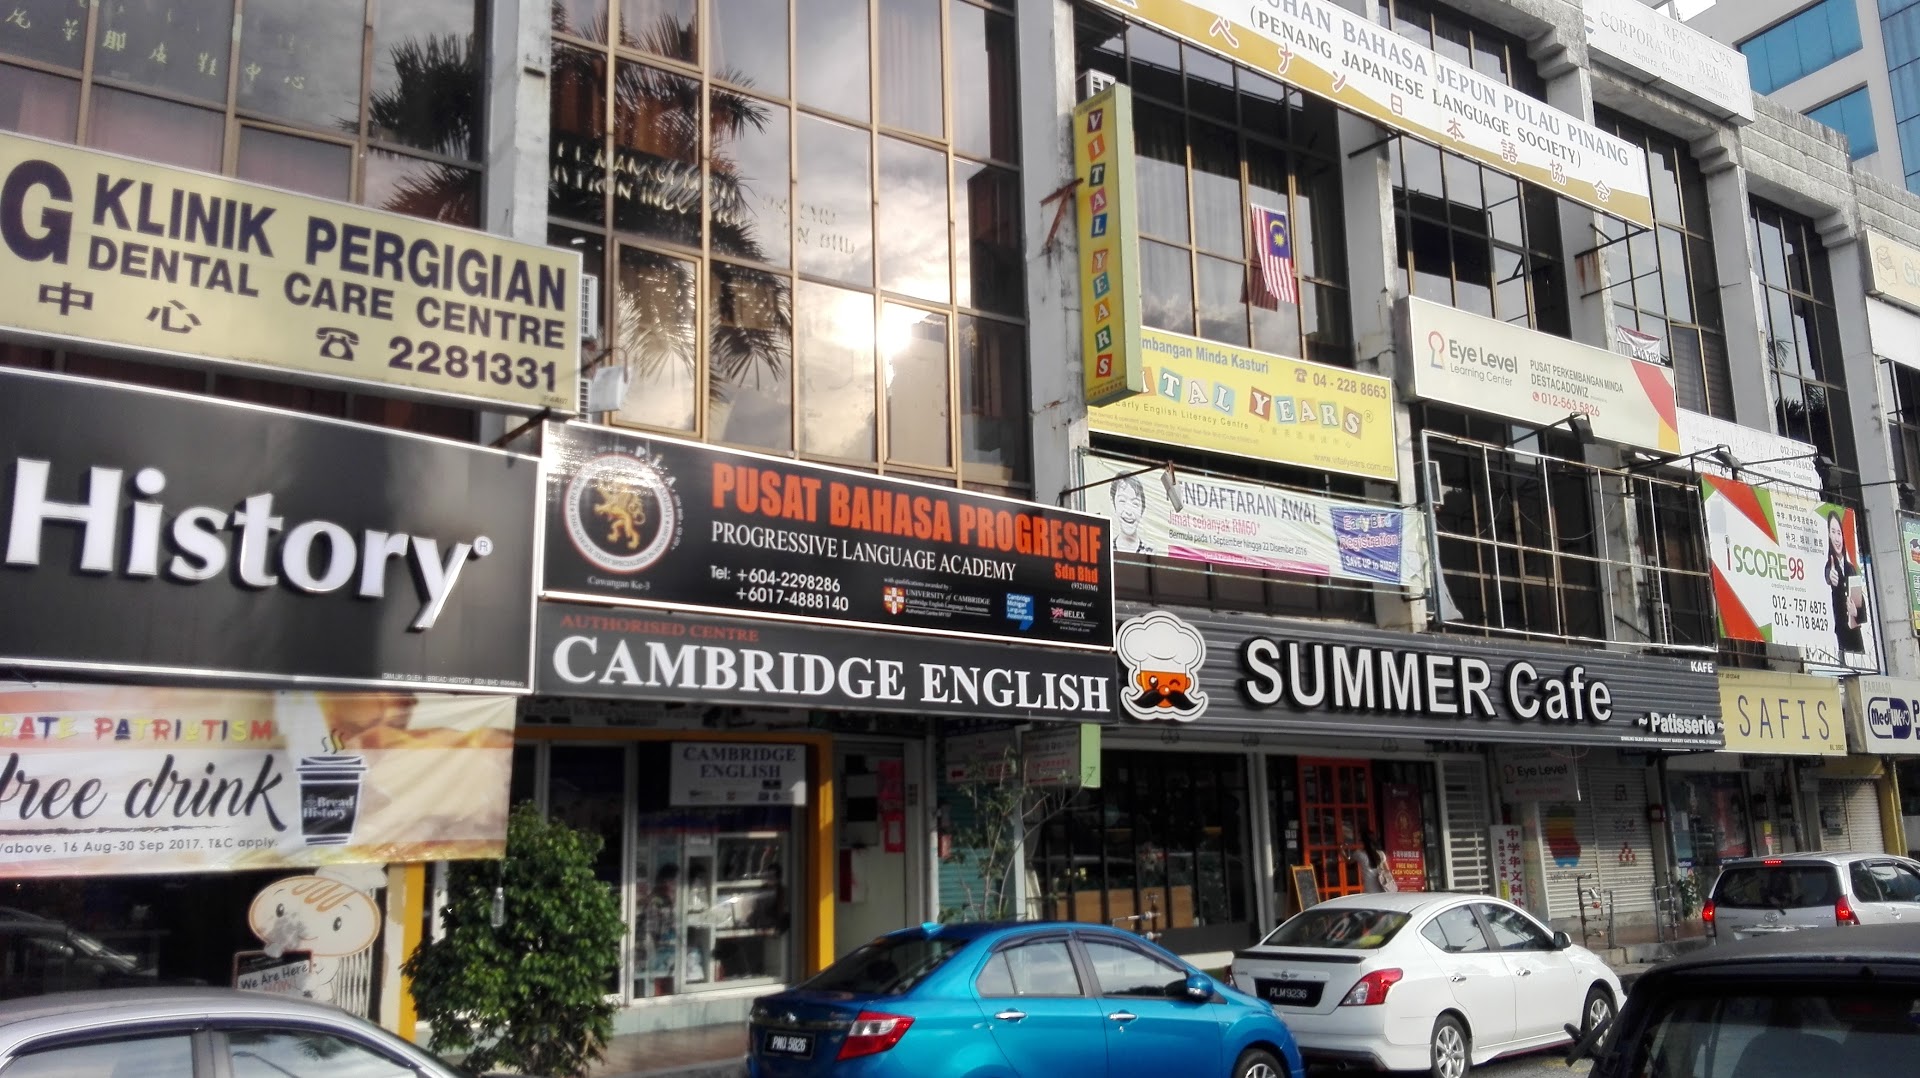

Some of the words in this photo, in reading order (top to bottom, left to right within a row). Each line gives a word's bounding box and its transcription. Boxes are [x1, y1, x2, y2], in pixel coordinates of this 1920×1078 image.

[1600, 11, 1690, 68] CORPORATION
[1250, 6, 1334, 60] (PENANG
[1341, 50, 1425, 99] JAPANESE
[1433, 90, 1511, 137] LANGUAGE
[1517, 127, 1582, 168] SOCIETY)
[1342, 18, 1428, 77] BAHASA
[1437, 63, 1497, 107] JEPUN
[1503, 94, 1560, 135] PULAU
[1567, 123, 1629, 166] PINANG
[1089, 111, 1105, 234] VITAL
[0, 159, 73, 264] G
[92, 172, 277, 258] KLINIK
[305, 215, 566, 312] PERGIGIAN
[88, 236, 259, 298] DENTAL
[284, 272, 394, 321] CARE
[416, 296, 566, 350] CENTRE
[1094, 253, 1111, 375] YEARS
[389, 336, 556, 392] 2281331
[1141, 337, 1192, 359] mbangan
[1196, 346, 1228, 366] Minda
[1231, 352, 1269, 374] Kasturi
[1337, 376, 1357, 393] 228
[1360, 381, 1387, 399] 8663
[1449, 339, 1477, 365] Eye
[1480, 347, 1518, 374] Level
[1450, 363, 1485, 382] Learning
[1486, 370, 1512, 388] Center
[1530, 360, 1551, 374] PUSAT
[1552, 364, 1604, 389] PERKEMBANGAN
[1604, 379, 1624, 394] MINDA
[1531, 374, 1589, 399] DESTACADOWIZ
[1141, 369, 1232, 413] ITAL
[1252, 391, 1360, 435] YEARS
[1541, 391, 1577, 412] 012-563
[1579, 401, 1601, 417] 5826
[1144, 405, 1177, 417] English
[1181, 411, 1216, 424] Literacy
[1220, 417, 1249, 429] Centre
[711, 462, 821, 522] PUSAT
[830, 481, 953, 543] BAHASA
[959, 503, 1101, 564] PROGRESIF
[1166, 481, 1277, 517] NDAFTARAN
[1281, 498, 1321, 525] AWAL
[1192, 514, 1230, 534] sebanyak
[1343, 514, 1369, 532] Early
[5, 457, 473, 631] History
[711, 520, 838, 558] PROGRESSIVE
[842, 539, 936, 572] LANGUAGE
[939, 554, 1016, 582] ACADEMY
[1168, 529, 1193, 542] Bermula
[1194, 533, 1208, 543] pada
[1213, 535, 1243, 548] September
[1243, 540, 1262, 552] hingga
[1270, 543, 1294, 555] Disember
[1340, 533, 1398, 551] Registration
[710, 565, 731, 581] Tel:
[738, 568, 841, 592] +604-2298286
[895, 578, 924, 588] qualifications
[1054, 563, 1075, 580] Sdn
[1078, 566, 1098, 584] Bhd
[737, 587, 849, 612] +6017-4888140
[905, 588, 945, 600] UNIVERSITY
[953, 594, 991, 605] CAMBRIDGE
[1007, 593, 1030, 602] Cambridge
[1007, 600, 1026, 608] Michigan
[1772, 594, 1787, 609] 012
[1794, 598, 1807, 612] 757
[1810, 600, 1827, 615] 6875
[1007, 606, 1027, 614] Language
[1775, 612, 1788, 627] 016
[1796, 615, 1810, 629] 718
[1812, 617, 1829, 631] 8429
[560, 614, 685, 637] AUTHORISED
[690, 625, 759, 642] CENTRE
[427, 675, 447, 683] BREAD
[553, 635, 906, 701] CAMBRIDGE
[920, 663, 1111, 712] ENGLISH
[1246, 638, 1496, 716] SUMMER
[1509, 661, 1612, 721] Cafe
[1691, 661, 1714, 674] KAFE
[1651, 712, 1715, 735] Patisserie
[1738, 695, 1829, 740] SAFIS
[683, 747, 796, 762] CAMBRIDGE
[700, 764, 781, 779] ENGLISH
[1517, 766, 1537, 777] Eye
[1539, 764, 1567, 775] Level
[124, 754, 287, 832] drink
[317, 795, 355, 808] Bread
[303, 808, 346, 820] History
[64, 842, 78, 852] 16
[84, 840, 135, 854] Aug-30
[139, 840, 164, 853] Sep
[168, 839, 203, 850] 2017.
[208, 838, 233, 848] T&C
[238, 837, 279, 849] apply.
[241, 979, 258, 989] We
[261, 973, 279, 985] Are
[282, 964, 307, 978] Here
[788, 1037, 807, 1052] 5826
